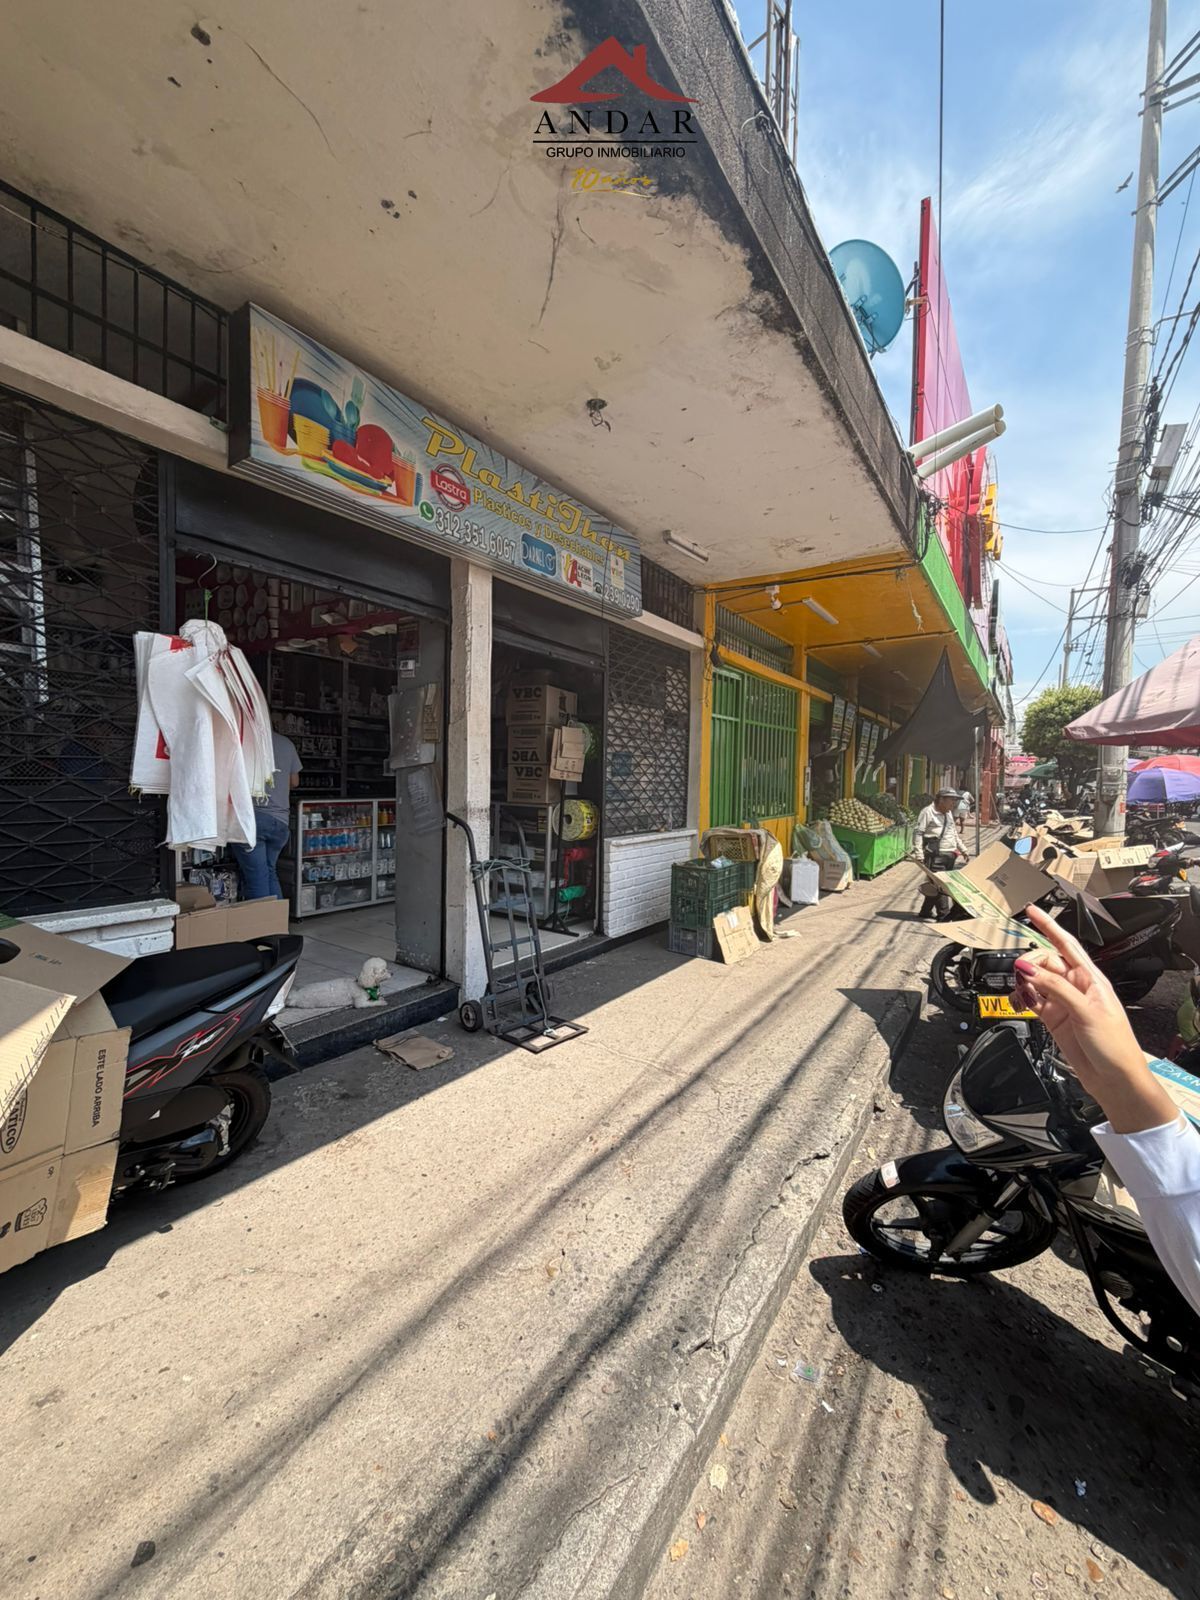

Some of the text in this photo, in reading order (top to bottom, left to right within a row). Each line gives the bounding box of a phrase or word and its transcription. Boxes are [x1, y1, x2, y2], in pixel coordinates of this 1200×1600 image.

[434, 474, 467, 500] Lastra
[436, 507, 517, 562] 312 351 6067
[91, 1049, 107, 1128] ESTE LADO ARRIBA
